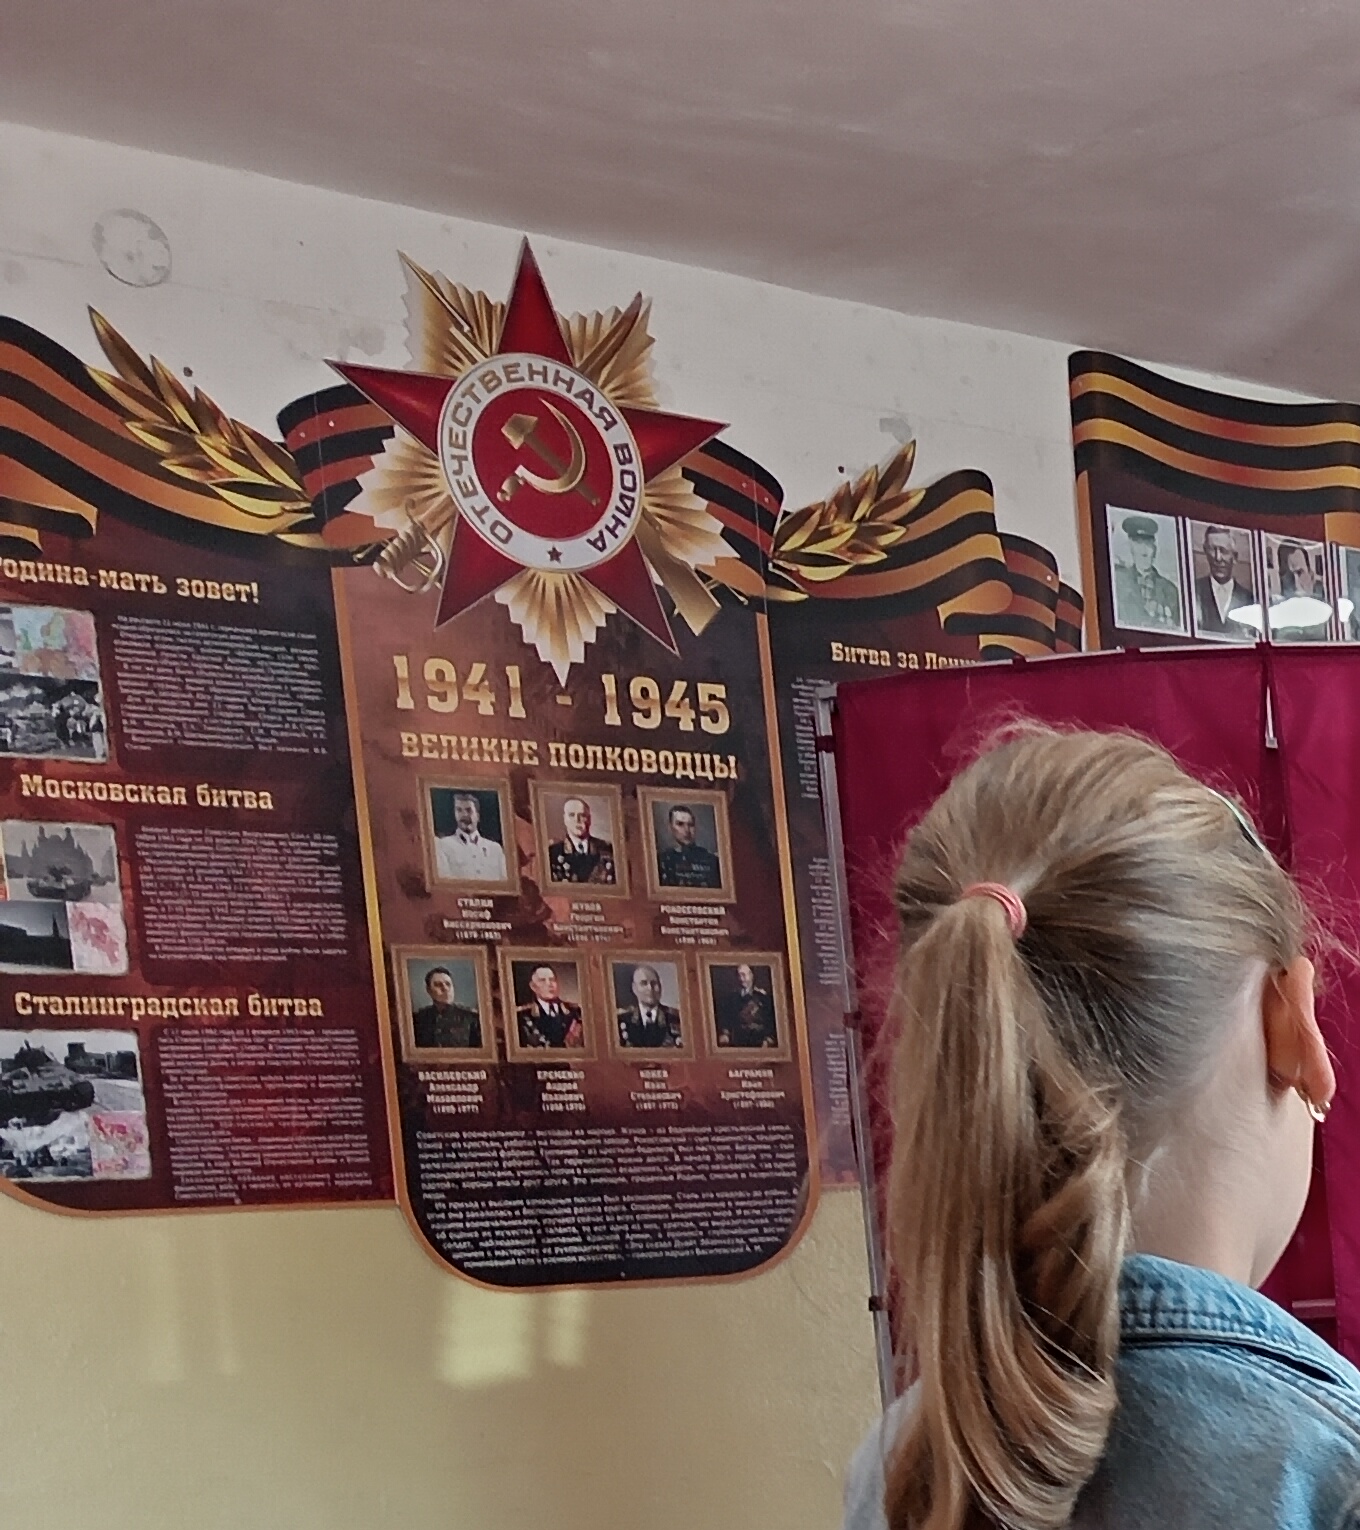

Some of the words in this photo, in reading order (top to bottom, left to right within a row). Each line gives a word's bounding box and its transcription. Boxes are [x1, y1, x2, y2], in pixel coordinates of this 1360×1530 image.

[448, 362, 618, 545] ОТЕЧЕСТВЕННАЯ
[0, 557, 168, 595] одина-мать
[175, 577, 260, 604] зовет!
[830, 641, 891, 667] Битва
[897, 651, 919, 670] за
[393, 655, 527, 719] 1941
[601, 673, 730, 735] 1945
[400, 732, 540, 767] ВЕЛИКИЕ
[548, 742, 739, 782] ПОЛКОВОДЦЫ
[20, 773, 188, 805] Московская
[196, 783, 275, 810] битва
[14, 991, 240, 1021] Сталинградская
[247, 991, 325, 1018] битва
